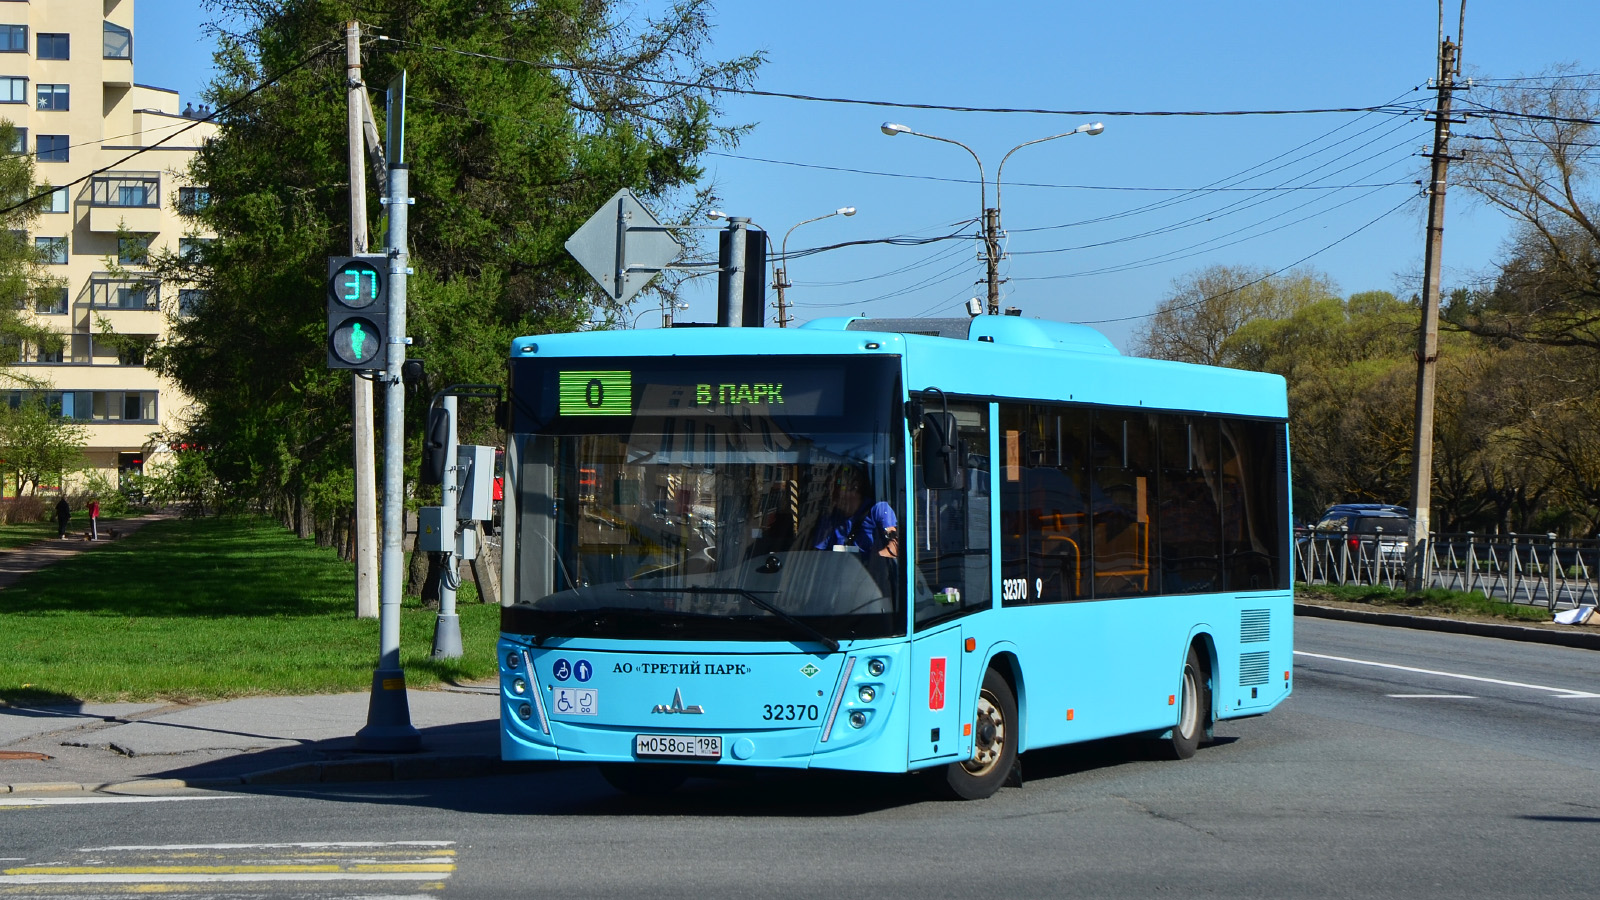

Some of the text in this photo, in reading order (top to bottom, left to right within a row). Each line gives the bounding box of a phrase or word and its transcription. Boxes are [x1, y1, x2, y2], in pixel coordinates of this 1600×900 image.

[344, 269, 377, 300] 37
[586, 378, 604, 409] 0
[697, 383, 785, 405] В ПАРК
[1002, 577, 1043, 601] 32370 9
[613, 660, 752, 675] АО «ТРЕТИЙ ПАРК»
[762, 704, 819, 721] 32370
